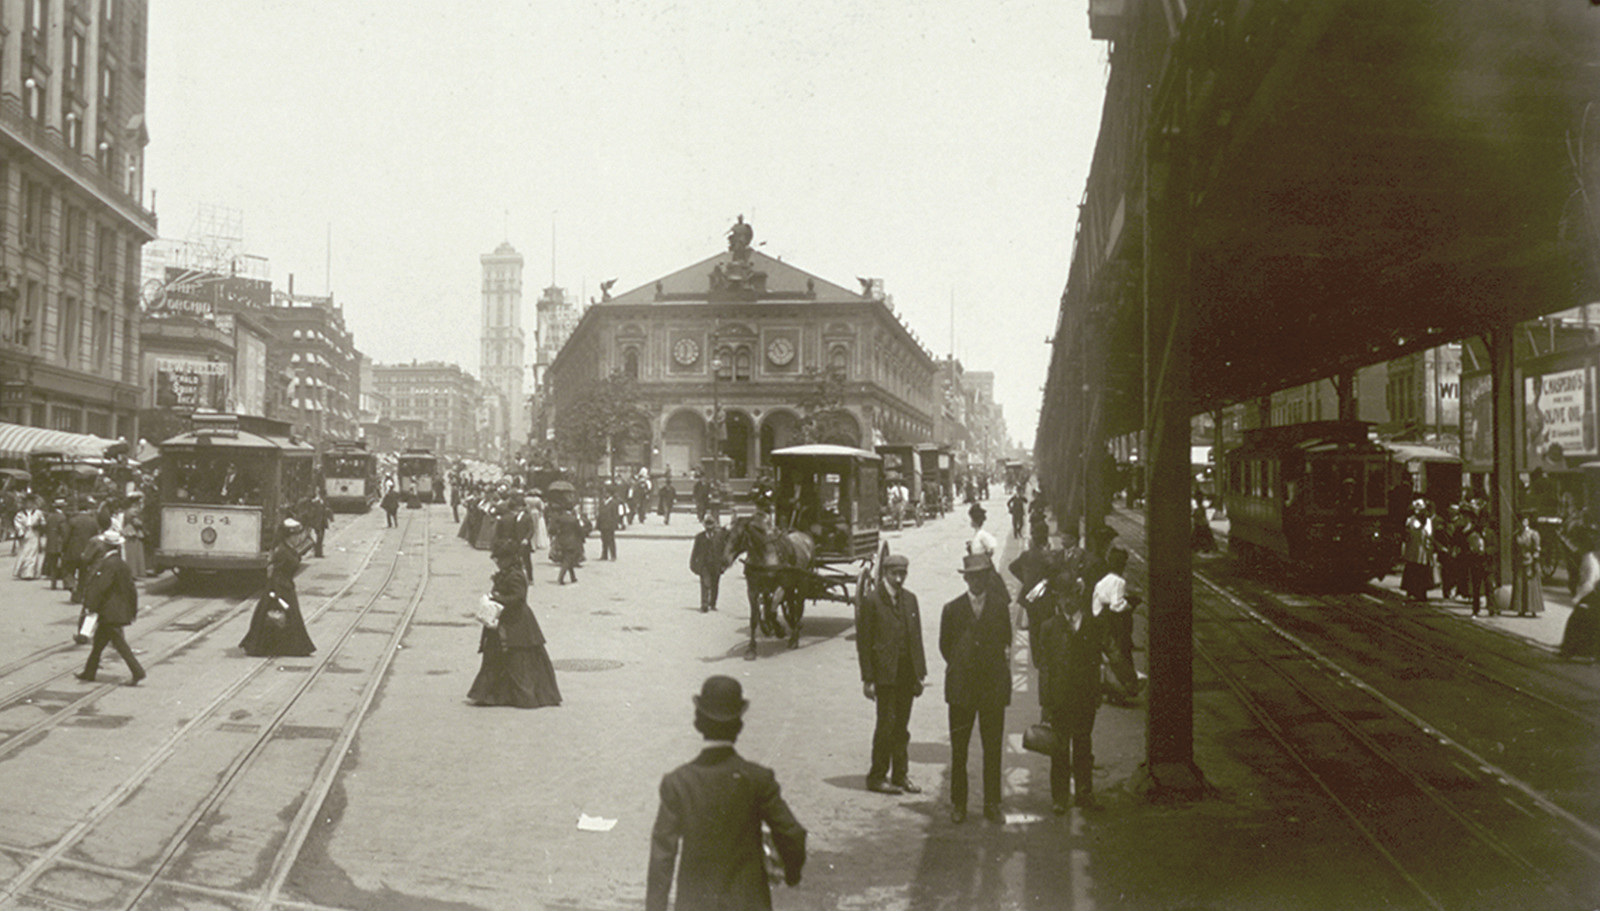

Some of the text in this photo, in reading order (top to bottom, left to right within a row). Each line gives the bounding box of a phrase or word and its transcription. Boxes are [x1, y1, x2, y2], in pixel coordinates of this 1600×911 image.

[1543, 406, 1582, 425] OLIVE OIL
[186, 514, 232, 525] 864
